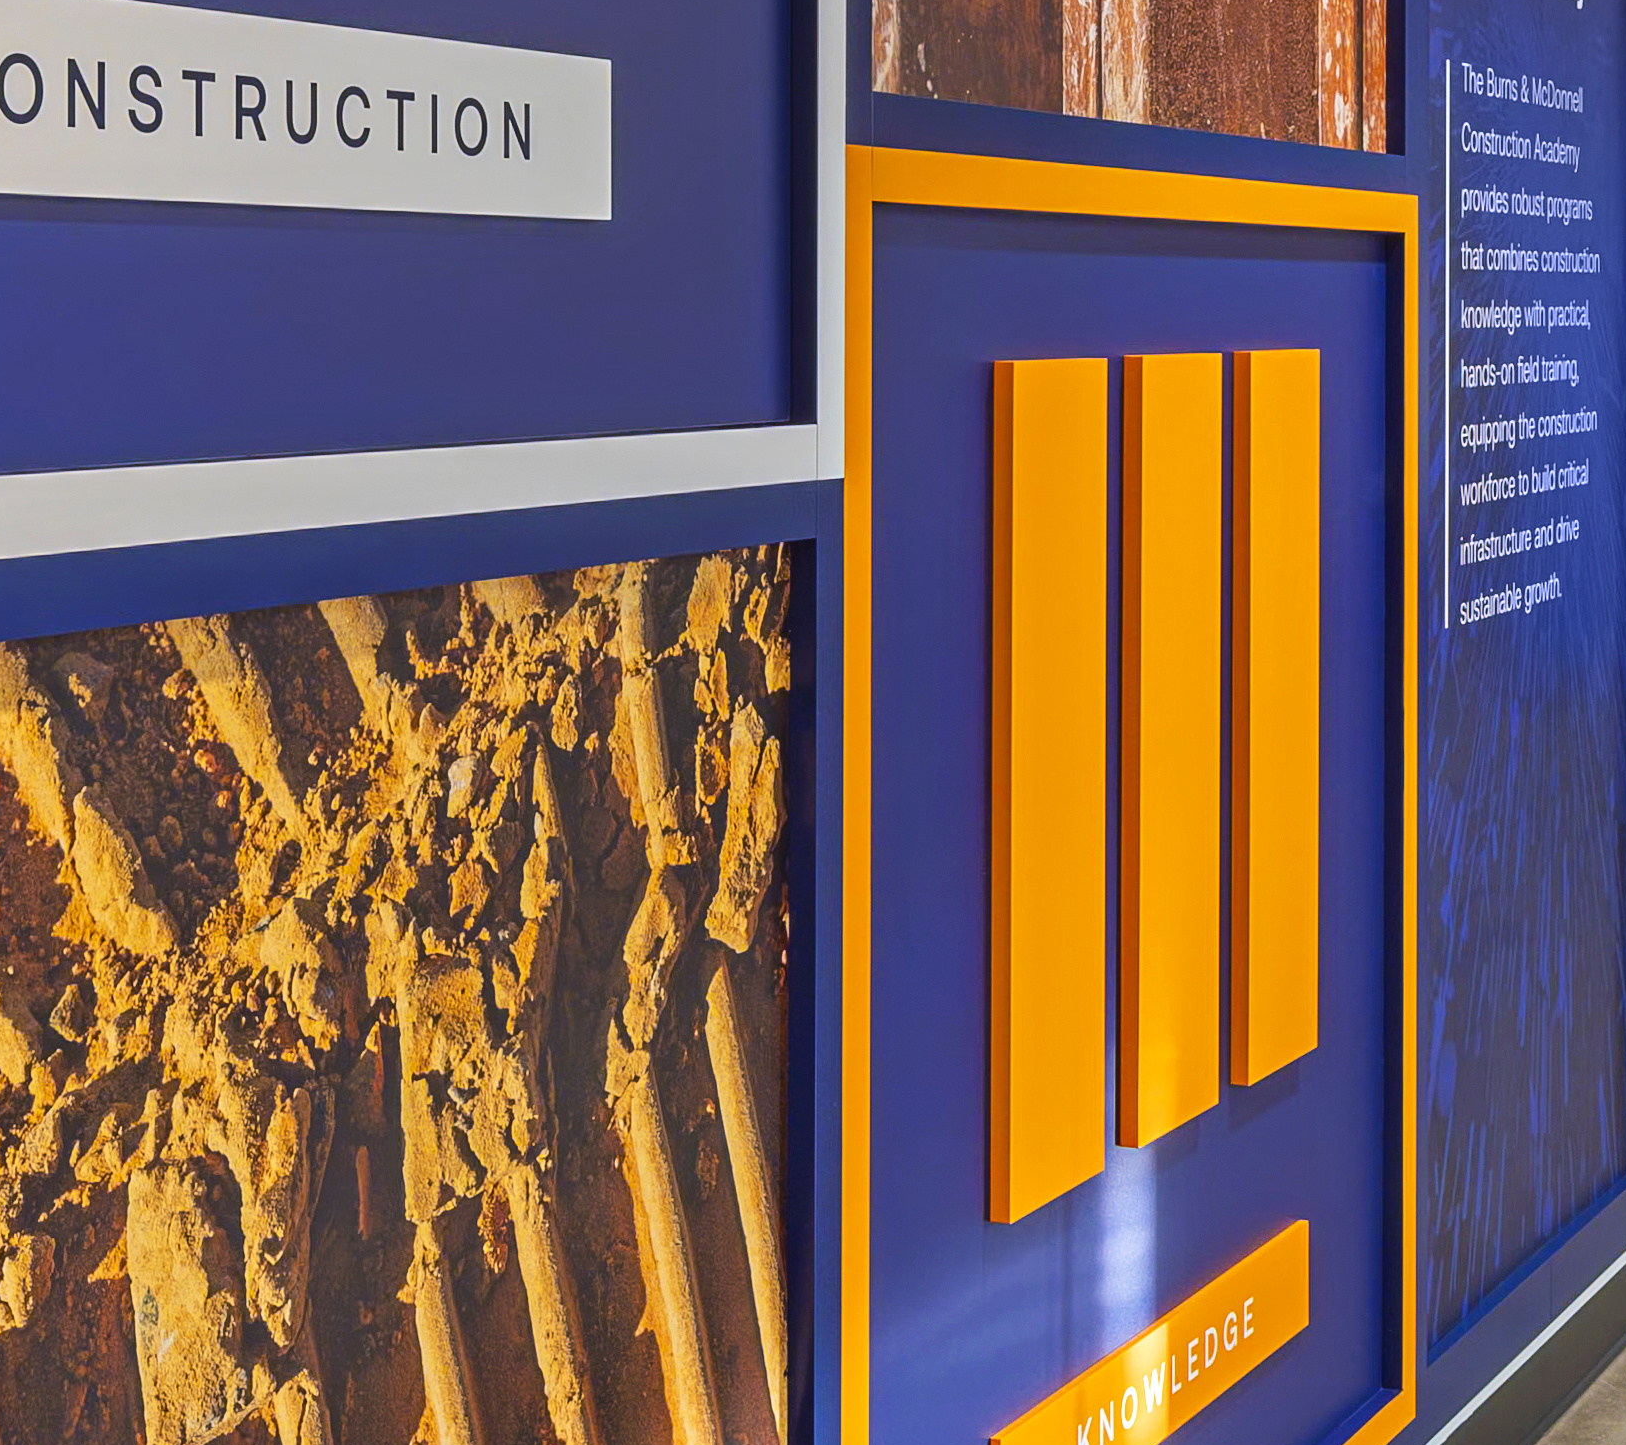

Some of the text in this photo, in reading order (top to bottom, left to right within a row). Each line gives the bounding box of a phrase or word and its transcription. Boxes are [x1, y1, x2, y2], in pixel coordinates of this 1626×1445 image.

[1461, 62, 1583, 113] The Burns & McDonnell
[1461, 122, 1580, 173] Construction Academy
[1461, 184, 1593, 225] provides robust programs
[1461, 241, 1600, 273] that combines construction
[1461, 300, 1590, 335] knowledge with practical,
[1461, 354, 1579, 388] hands-on field training,
[1461, 406, 1597, 454] equipping the construction
[1460, 458, 1589, 506] workforce to build critical
[1460, 515, 1580, 565] infrastructure and drive
[1460, 572, 1562, 625] sustainable growth.
